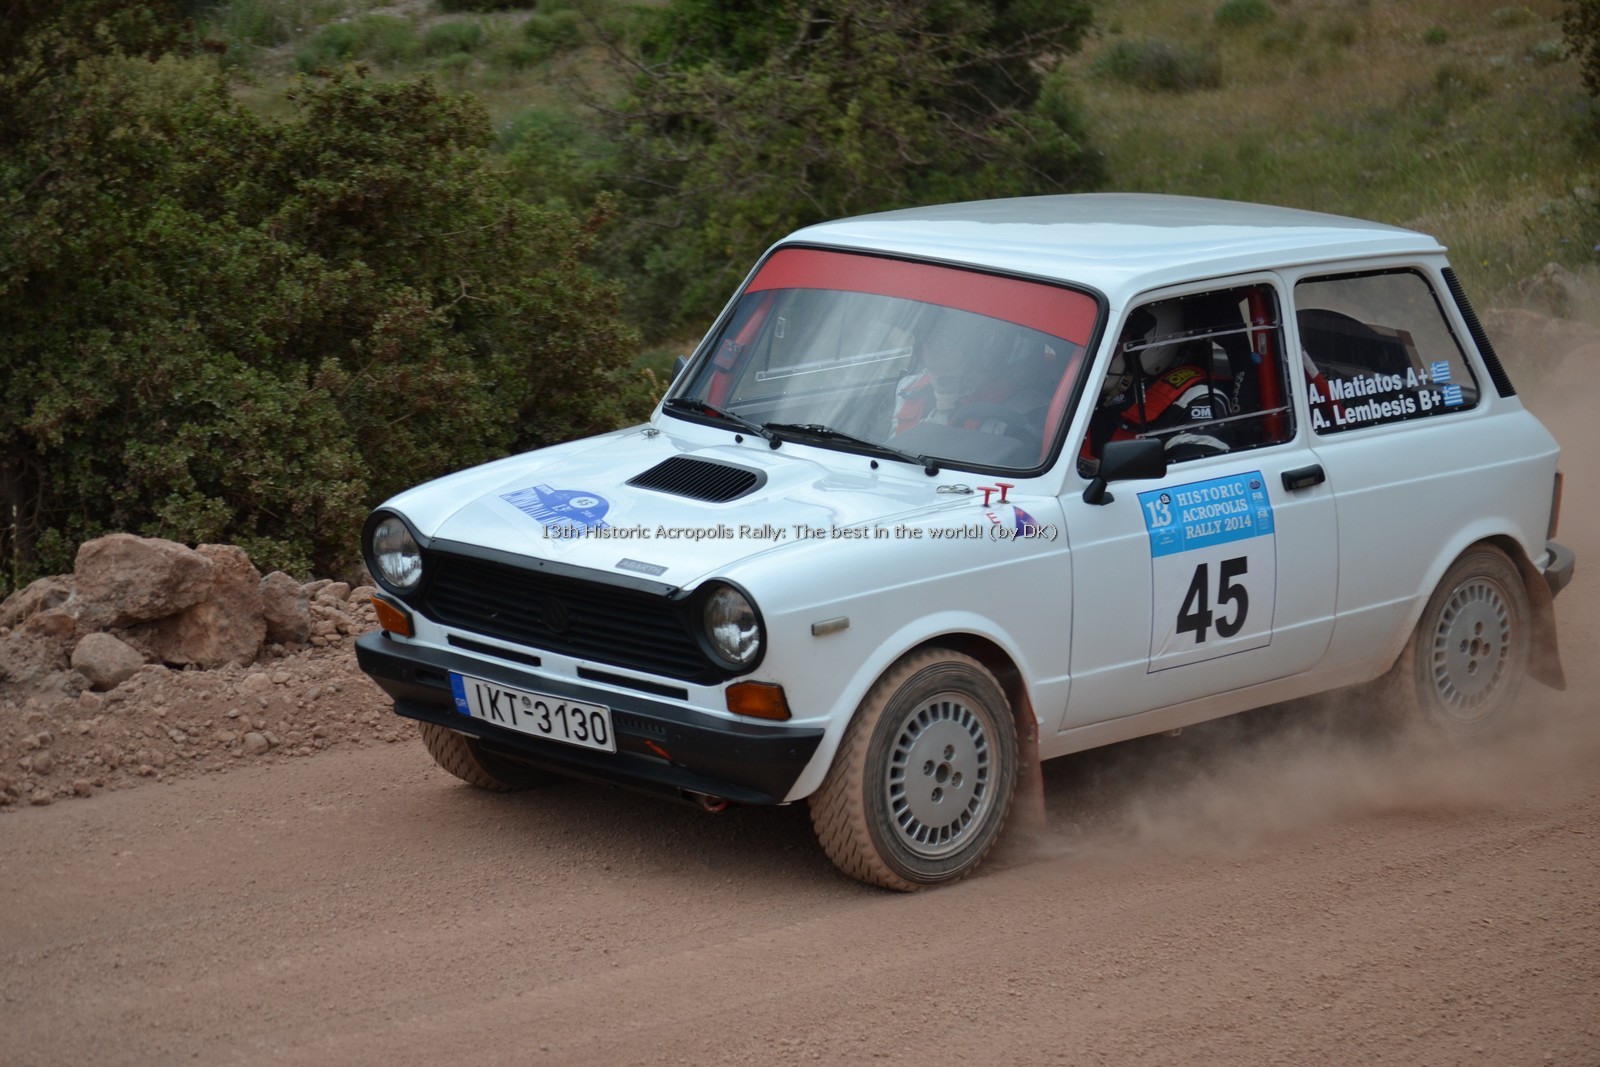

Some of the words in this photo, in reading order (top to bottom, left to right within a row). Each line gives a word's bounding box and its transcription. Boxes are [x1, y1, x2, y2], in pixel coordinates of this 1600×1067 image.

[1309, 384, 1325, 404] A.
[1328, 373, 1402, 400] Matiatos
[1407, 367, 1428, 388] A+
[1191, 407, 1212, 418] OM
[1313, 408, 1330, 429] A.
[1333, 394, 1416, 425] Lembesis
[1419, 390, 1441, 410] B+
[1176, 482, 1244, 507] HISTORIC
[1183, 498, 1248, 523] ACROPOLIS
[1185, 520, 1222, 539] RALLY
[1225, 514, 1252, 531] 2014
[1176, 556, 1248, 644] 45
[476, 684, 607, 745] IKT-3130
